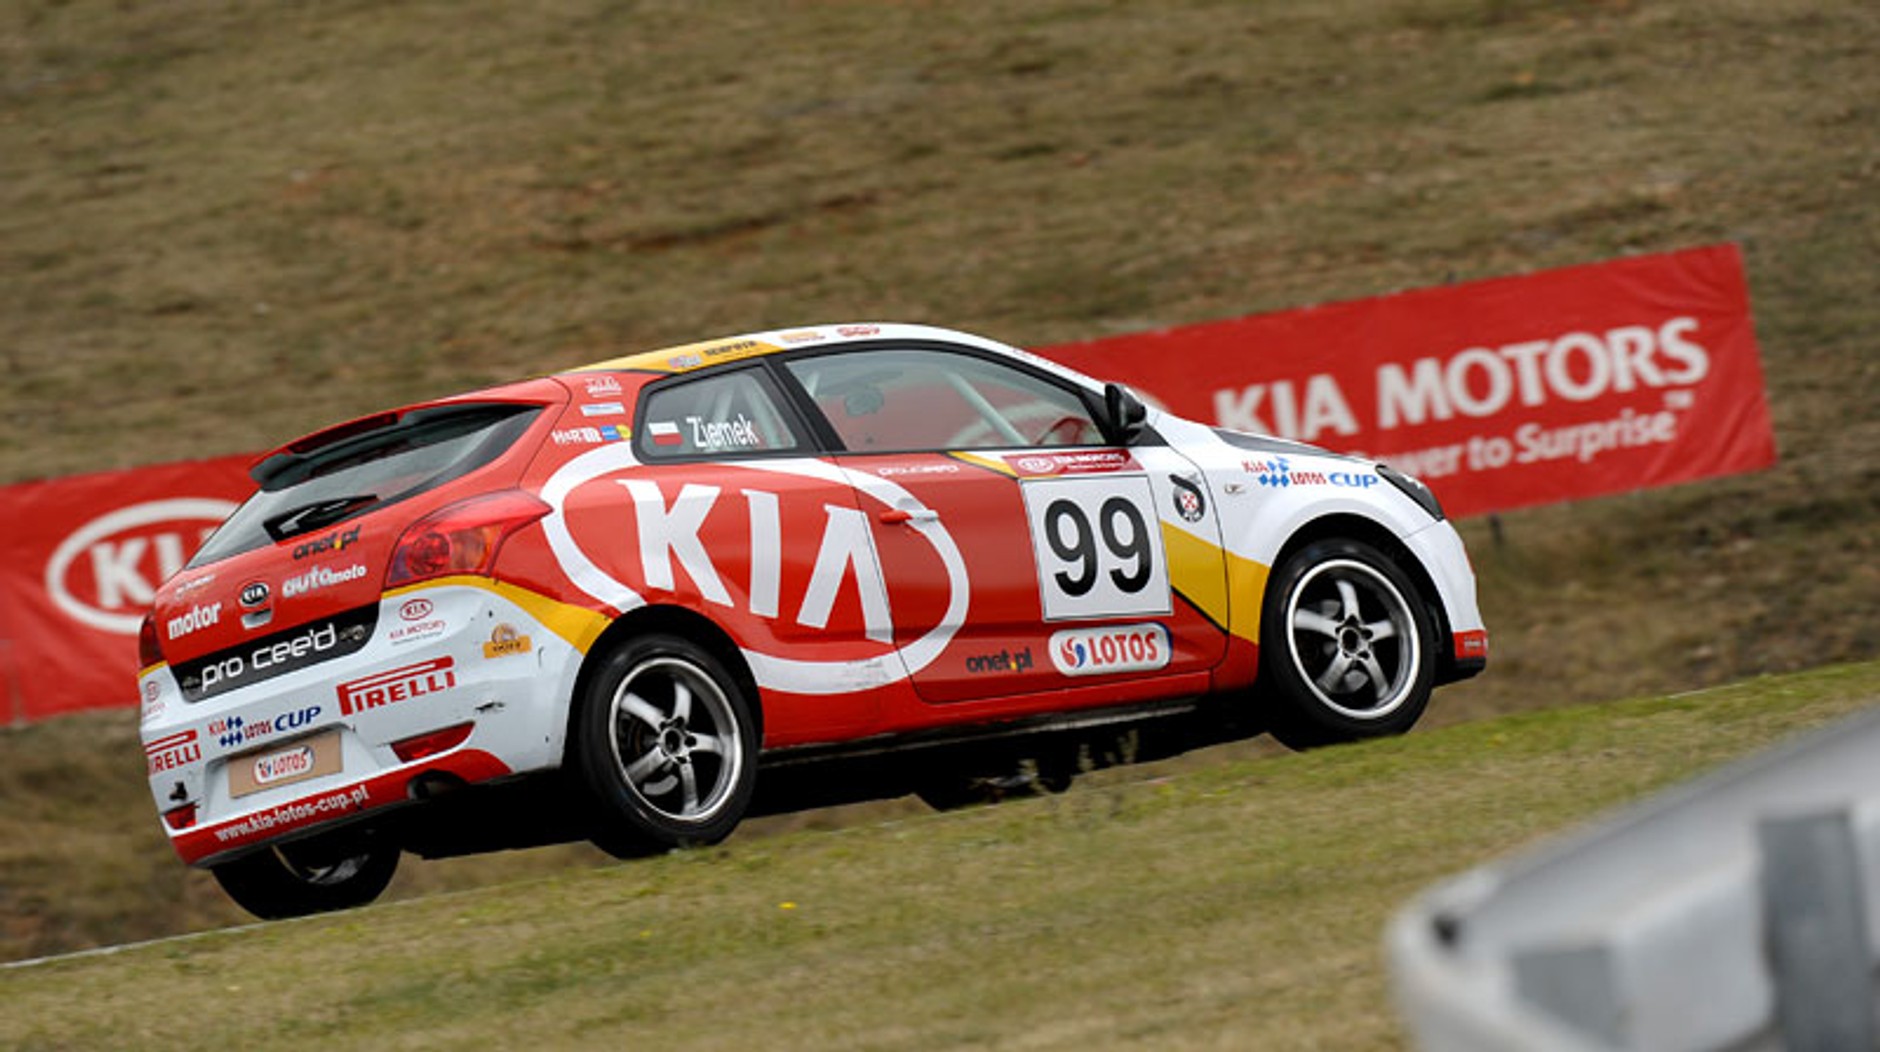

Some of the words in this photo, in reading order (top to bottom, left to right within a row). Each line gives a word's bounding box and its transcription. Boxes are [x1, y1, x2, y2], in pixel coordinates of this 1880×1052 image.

[1213, 374, 1358, 440] KIA
[1376, 317, 1710, 429] MOTORS
[686, 413, 760, 448] Ziemek
[1467, 431, 1512, 471] to
[1515, 408, 1677, 462] Surprise
[1329, 472, 1379, 489] CUP
[616, 478, 895, 645] KIA
[1044, 496, 1152, 597] 99
[91, 527, 216, 609] KI
[167, 602, 222, 640] motor
[406, 603, 428, 616] KIA
[201, 656, 244, 692] pro
[251, 622, 337, 669] cee'd
[965, 647, 1033, 673] onet.pl
[1087, 631, 1158, 665] LOTOS
[336, 655, 456, 717] PIRELLI
[208, 719, 227, 737] KIA
[274, 706, 321, 731] CUP
[272, 751, 308, 776] LOTOS
[214, 784, 370, 842] www.kia-lotos-cup.pl
